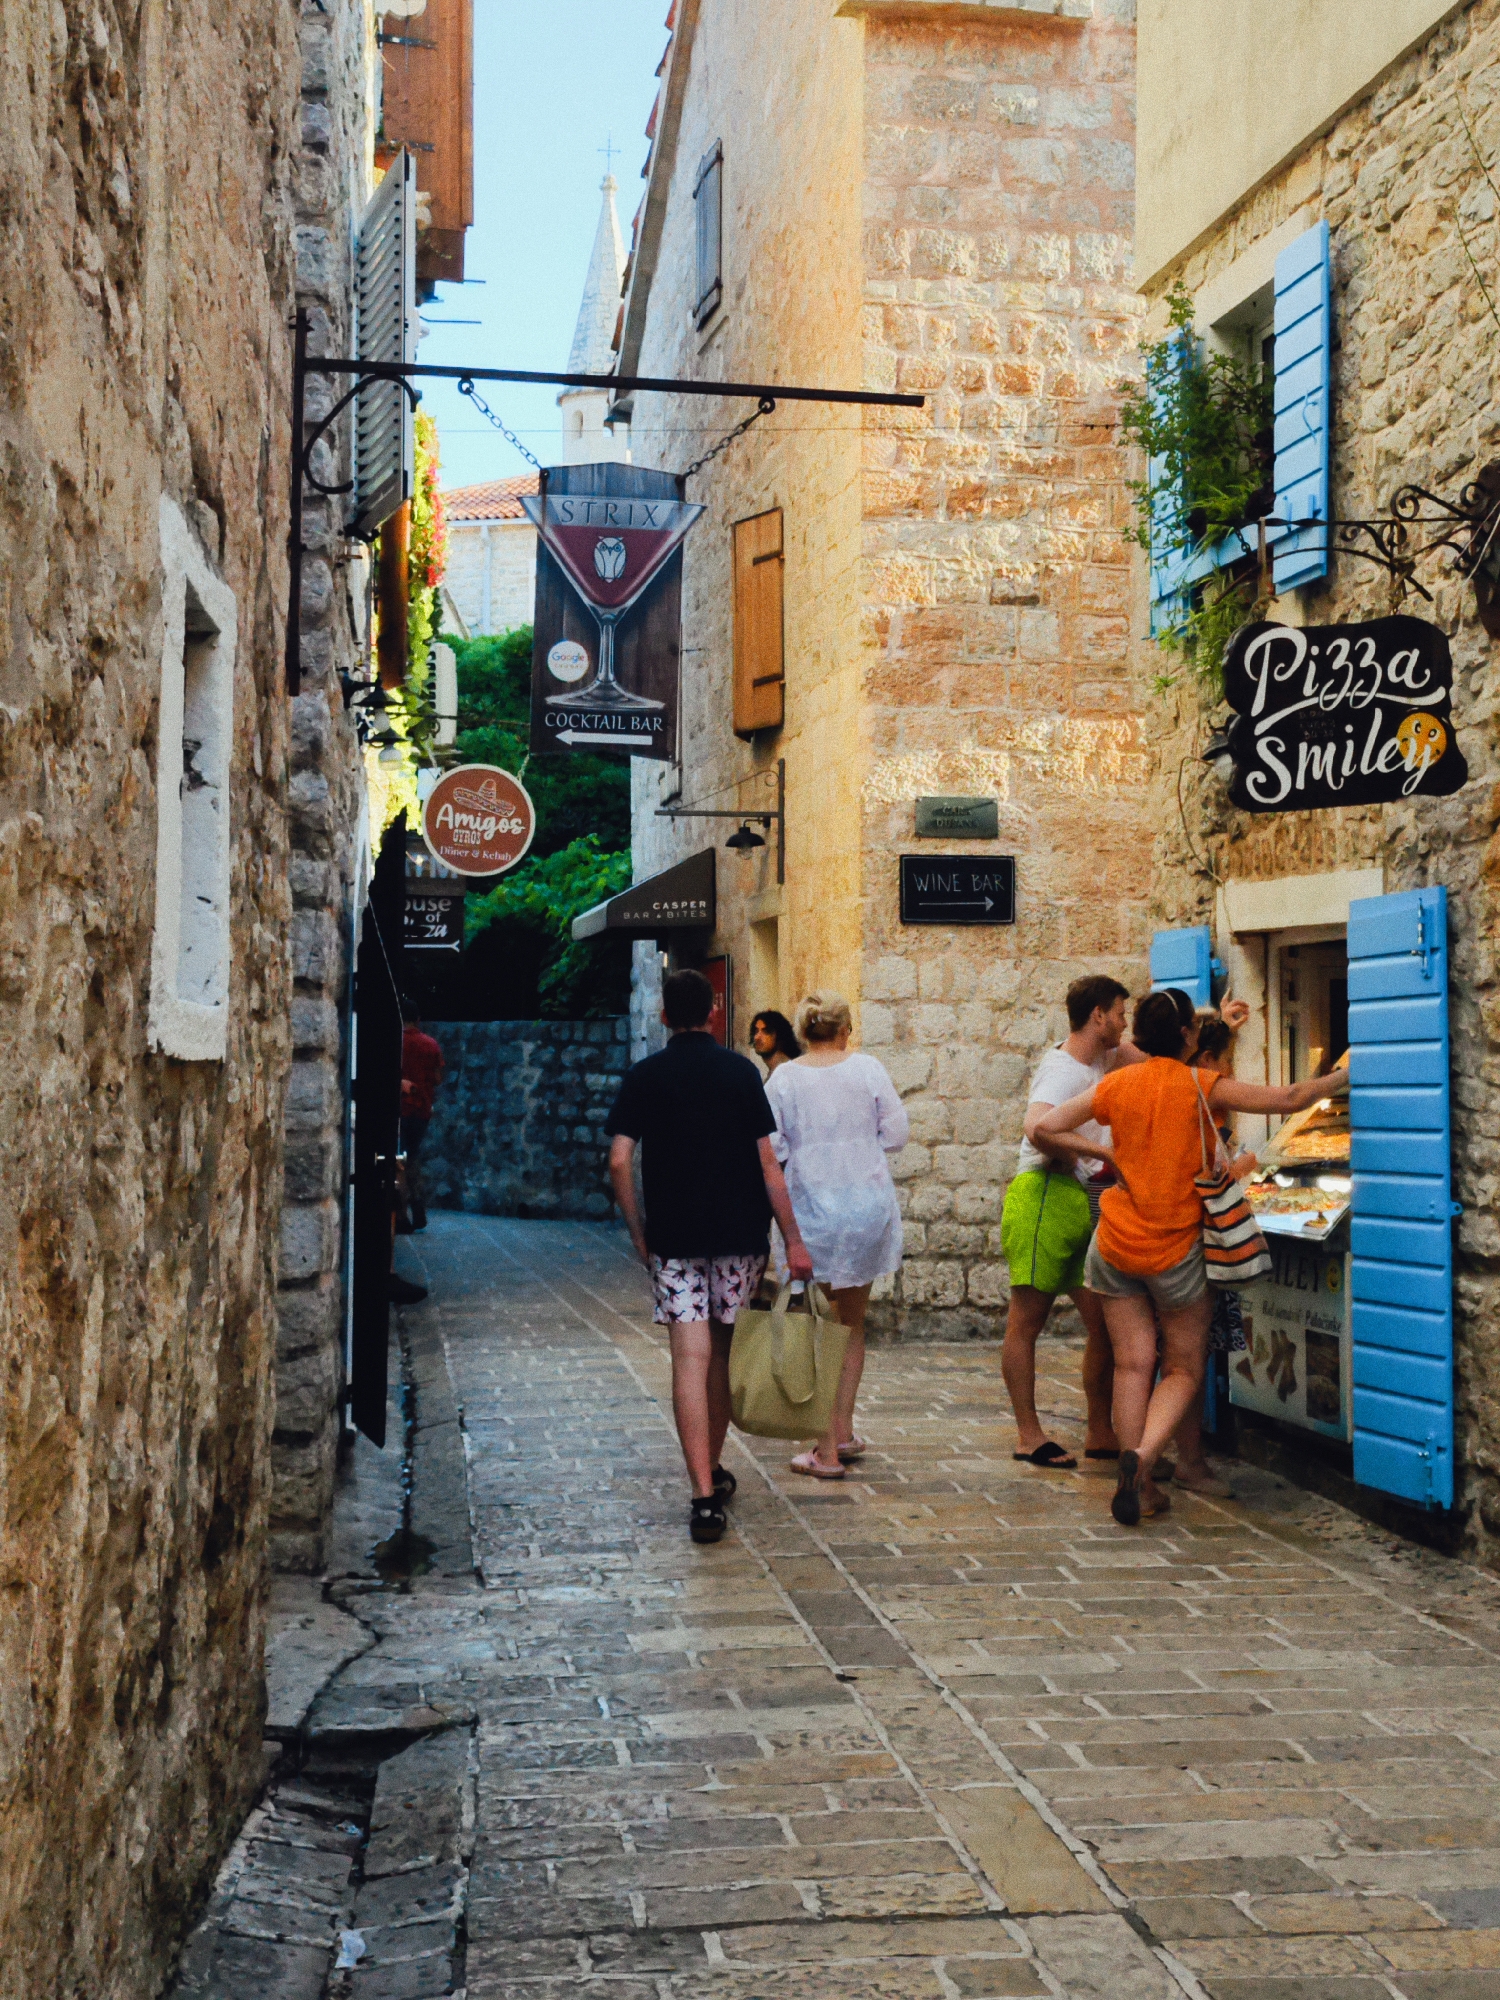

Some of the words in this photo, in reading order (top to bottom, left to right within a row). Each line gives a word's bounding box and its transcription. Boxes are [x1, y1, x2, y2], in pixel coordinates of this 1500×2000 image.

[561, 500, 660, 527] STRIX
[551, 651, 585, 664] Google
[1244, 626, 1432, 717] Pizza
[545, 712, 626, 730] COCKTAIL
[630, 716, 664, 731] BAR
[1245, 707, 1437, 804] Smiley
[435, 803, 526, 840] Amigos
[912, 873, 962, 892] WINE
[971, 873, 1005, 892] BAR
[623, 911, 650, 919] BAR
[666, 909, 707, 919] BITES
[652, 901, 707, 910] CASPER
[425, 911, 441, 923] of
